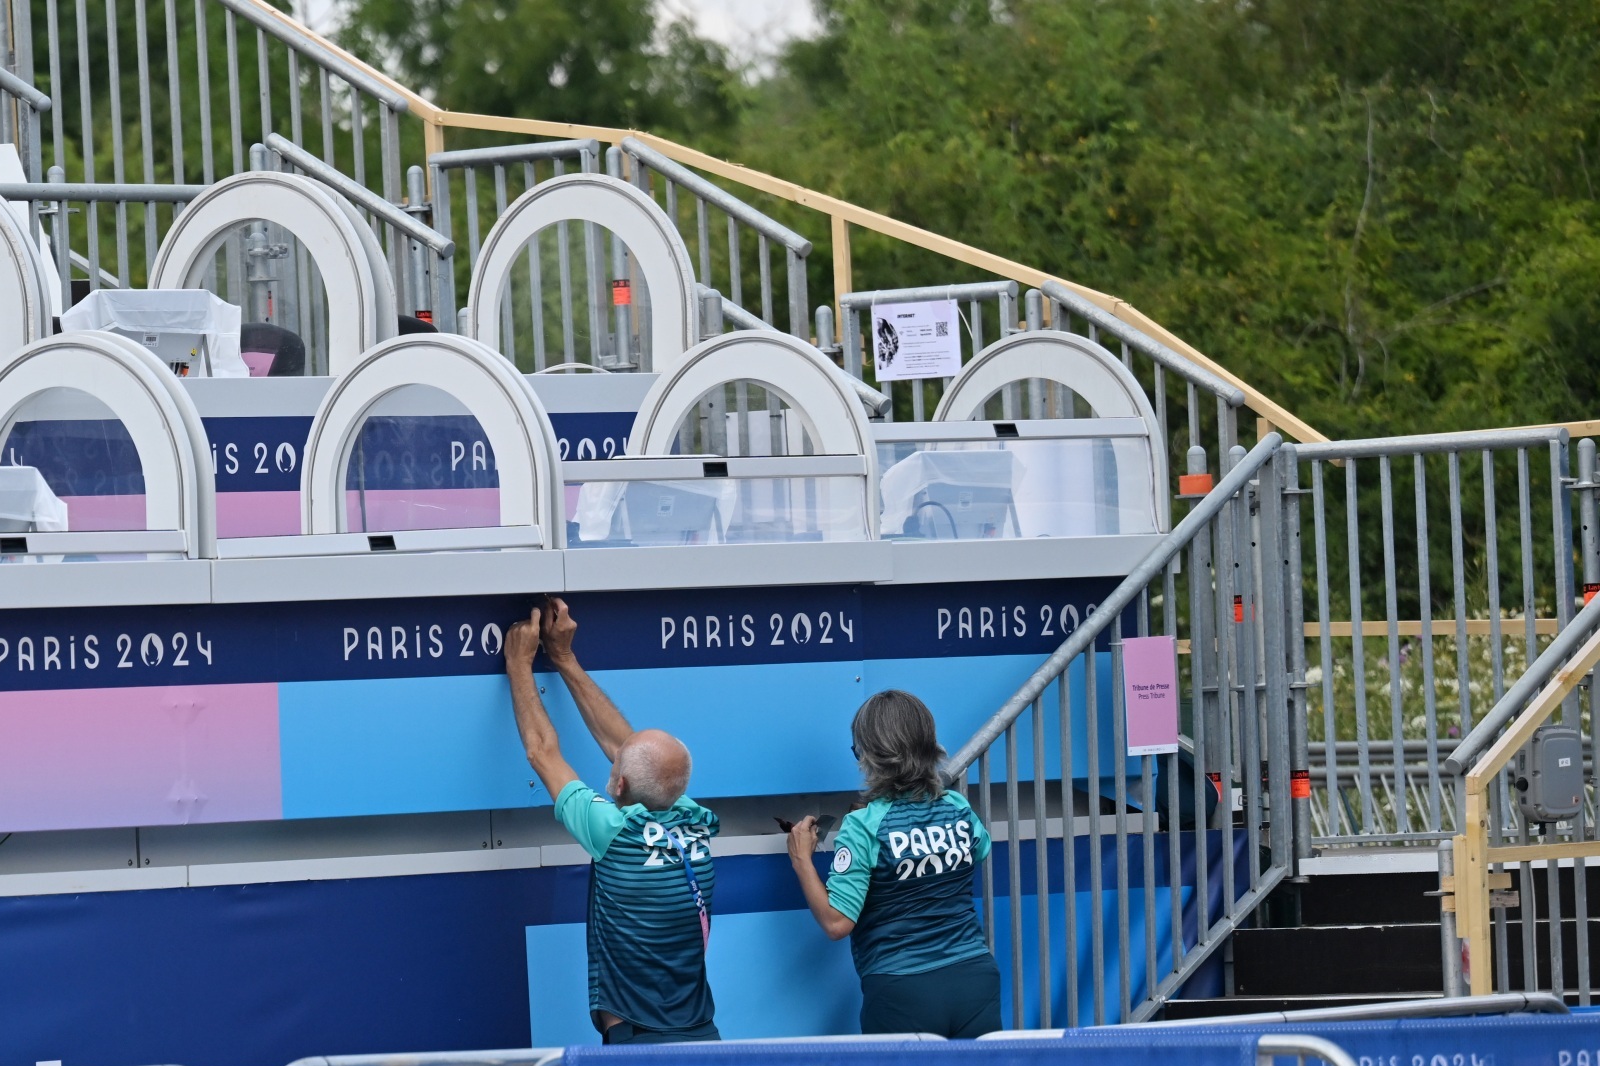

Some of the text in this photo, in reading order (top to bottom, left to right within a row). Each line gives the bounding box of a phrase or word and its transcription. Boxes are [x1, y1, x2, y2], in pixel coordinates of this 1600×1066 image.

[770, 611, 854, 646] 2024
[116, 631, 212, 668] 2024
[1132, 684, 1149, 692] Tribune
